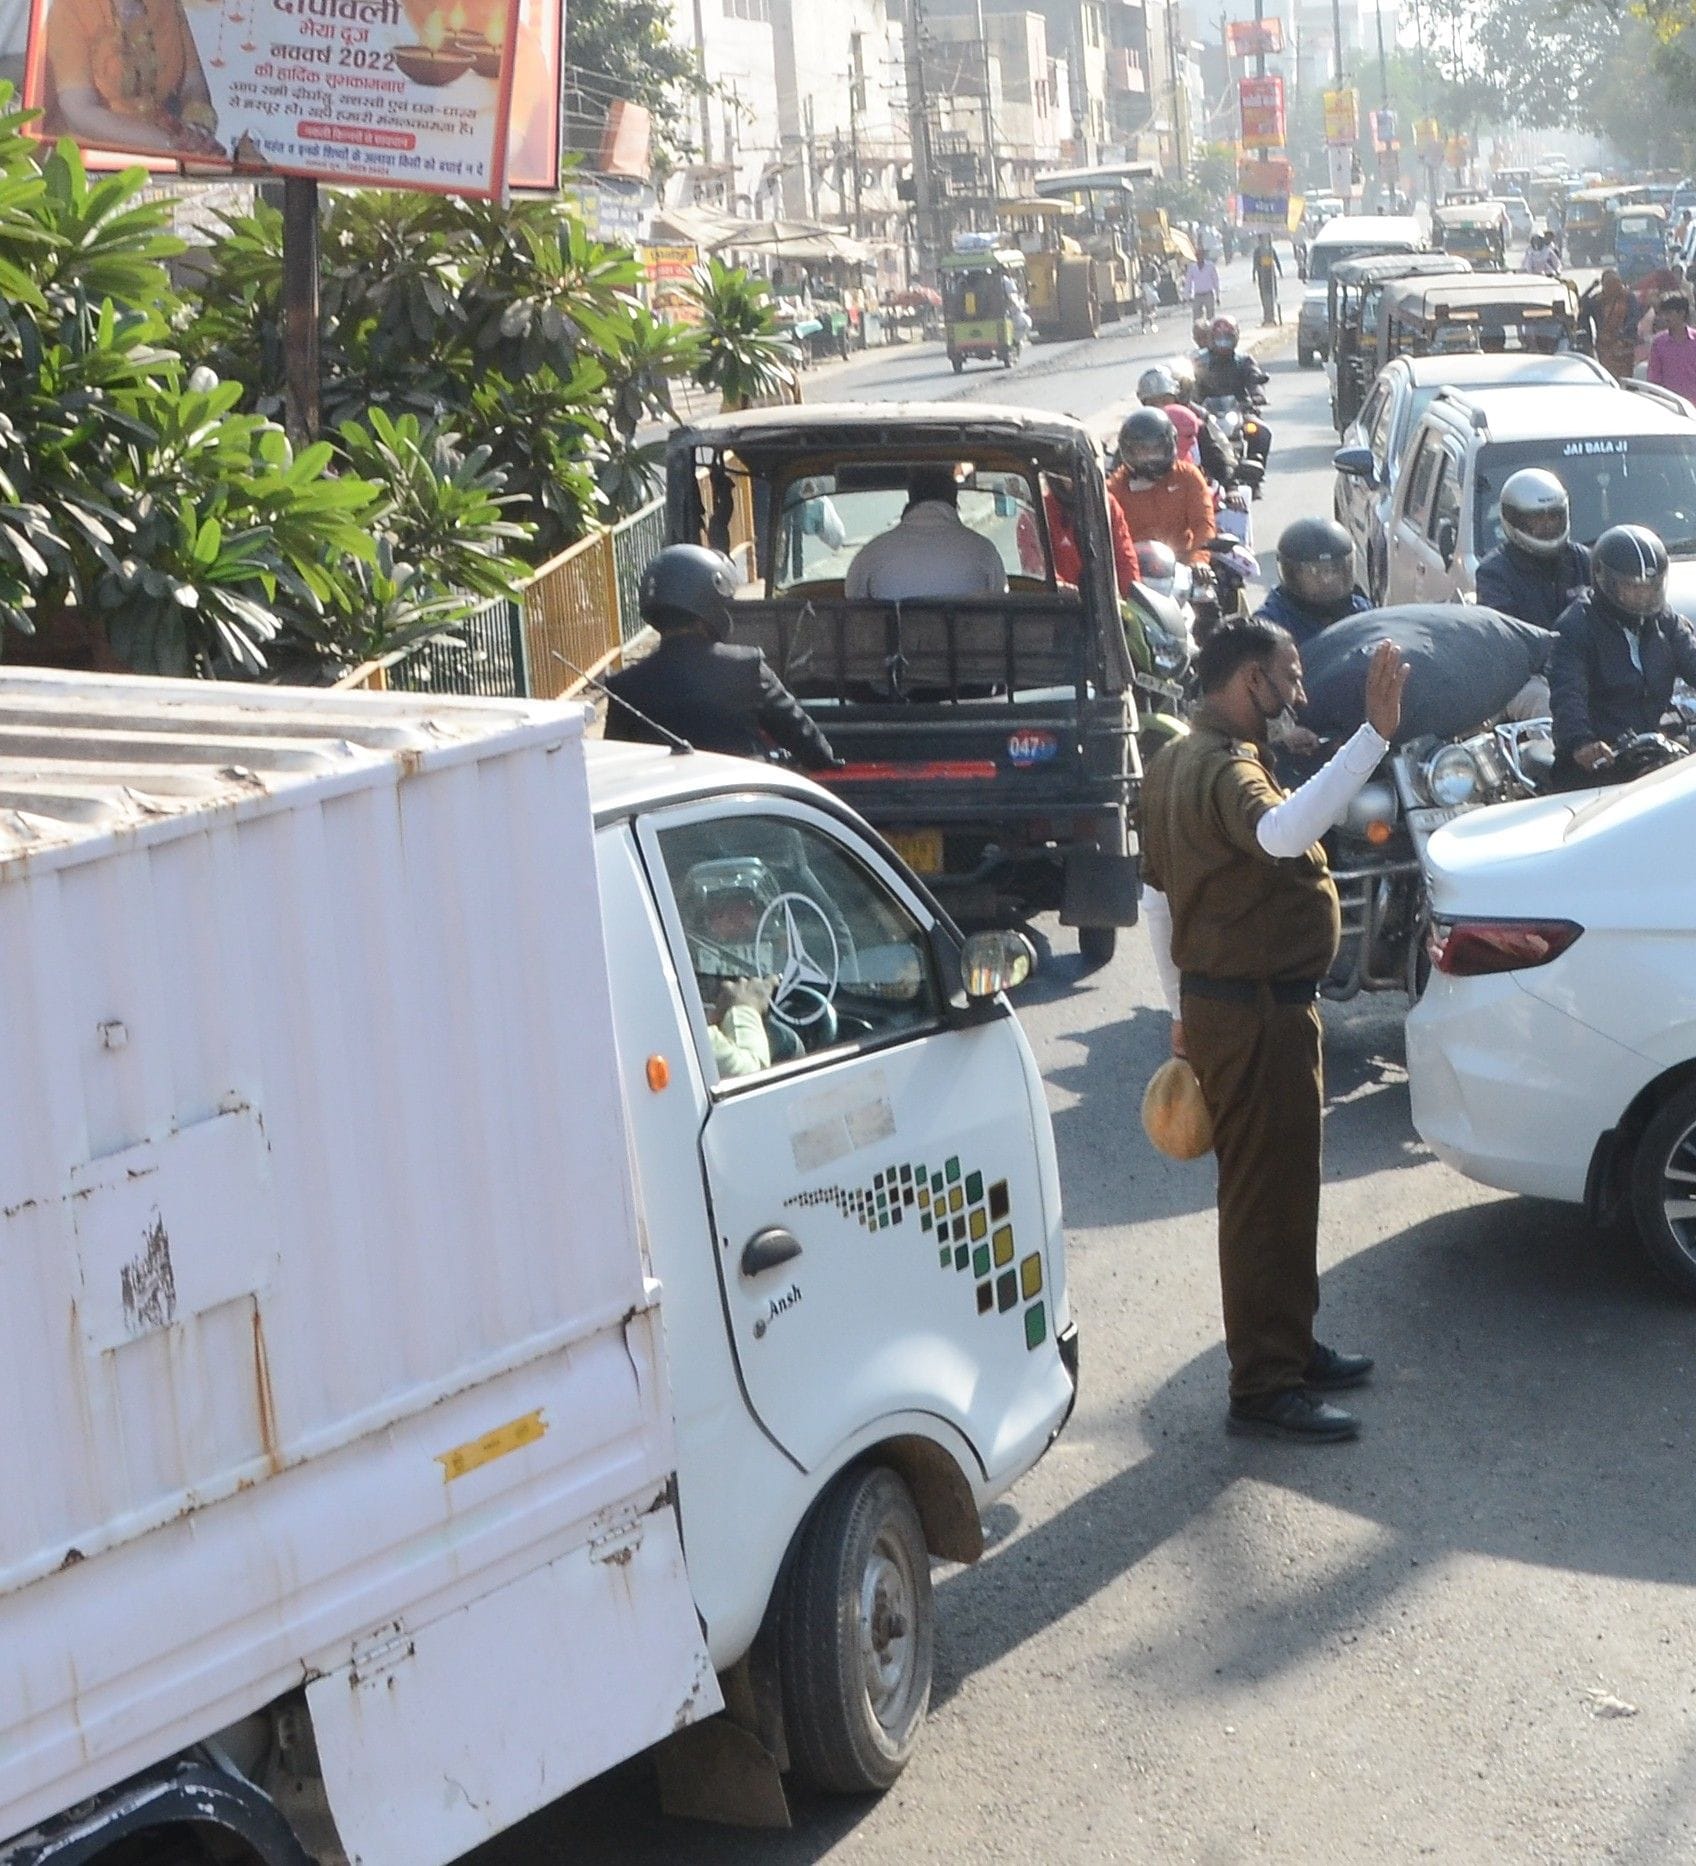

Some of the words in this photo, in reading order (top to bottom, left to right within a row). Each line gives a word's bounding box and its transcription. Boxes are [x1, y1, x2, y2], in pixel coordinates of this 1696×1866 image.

[341, 24, 369, 46] दूज
[270, 41, 331, 65] नववर्ष
[340, 48, 396, 71] 2022
[254, 62, 273, 78] की
[276, 66, 320, 84] हार्दिक
[1563, 442, 1583, 456] JAI
[1584, 440, 1614, 455] BALA
[1615, 440, 1628, 453] JI
[767, 1284, 802, 1325] Ansh
